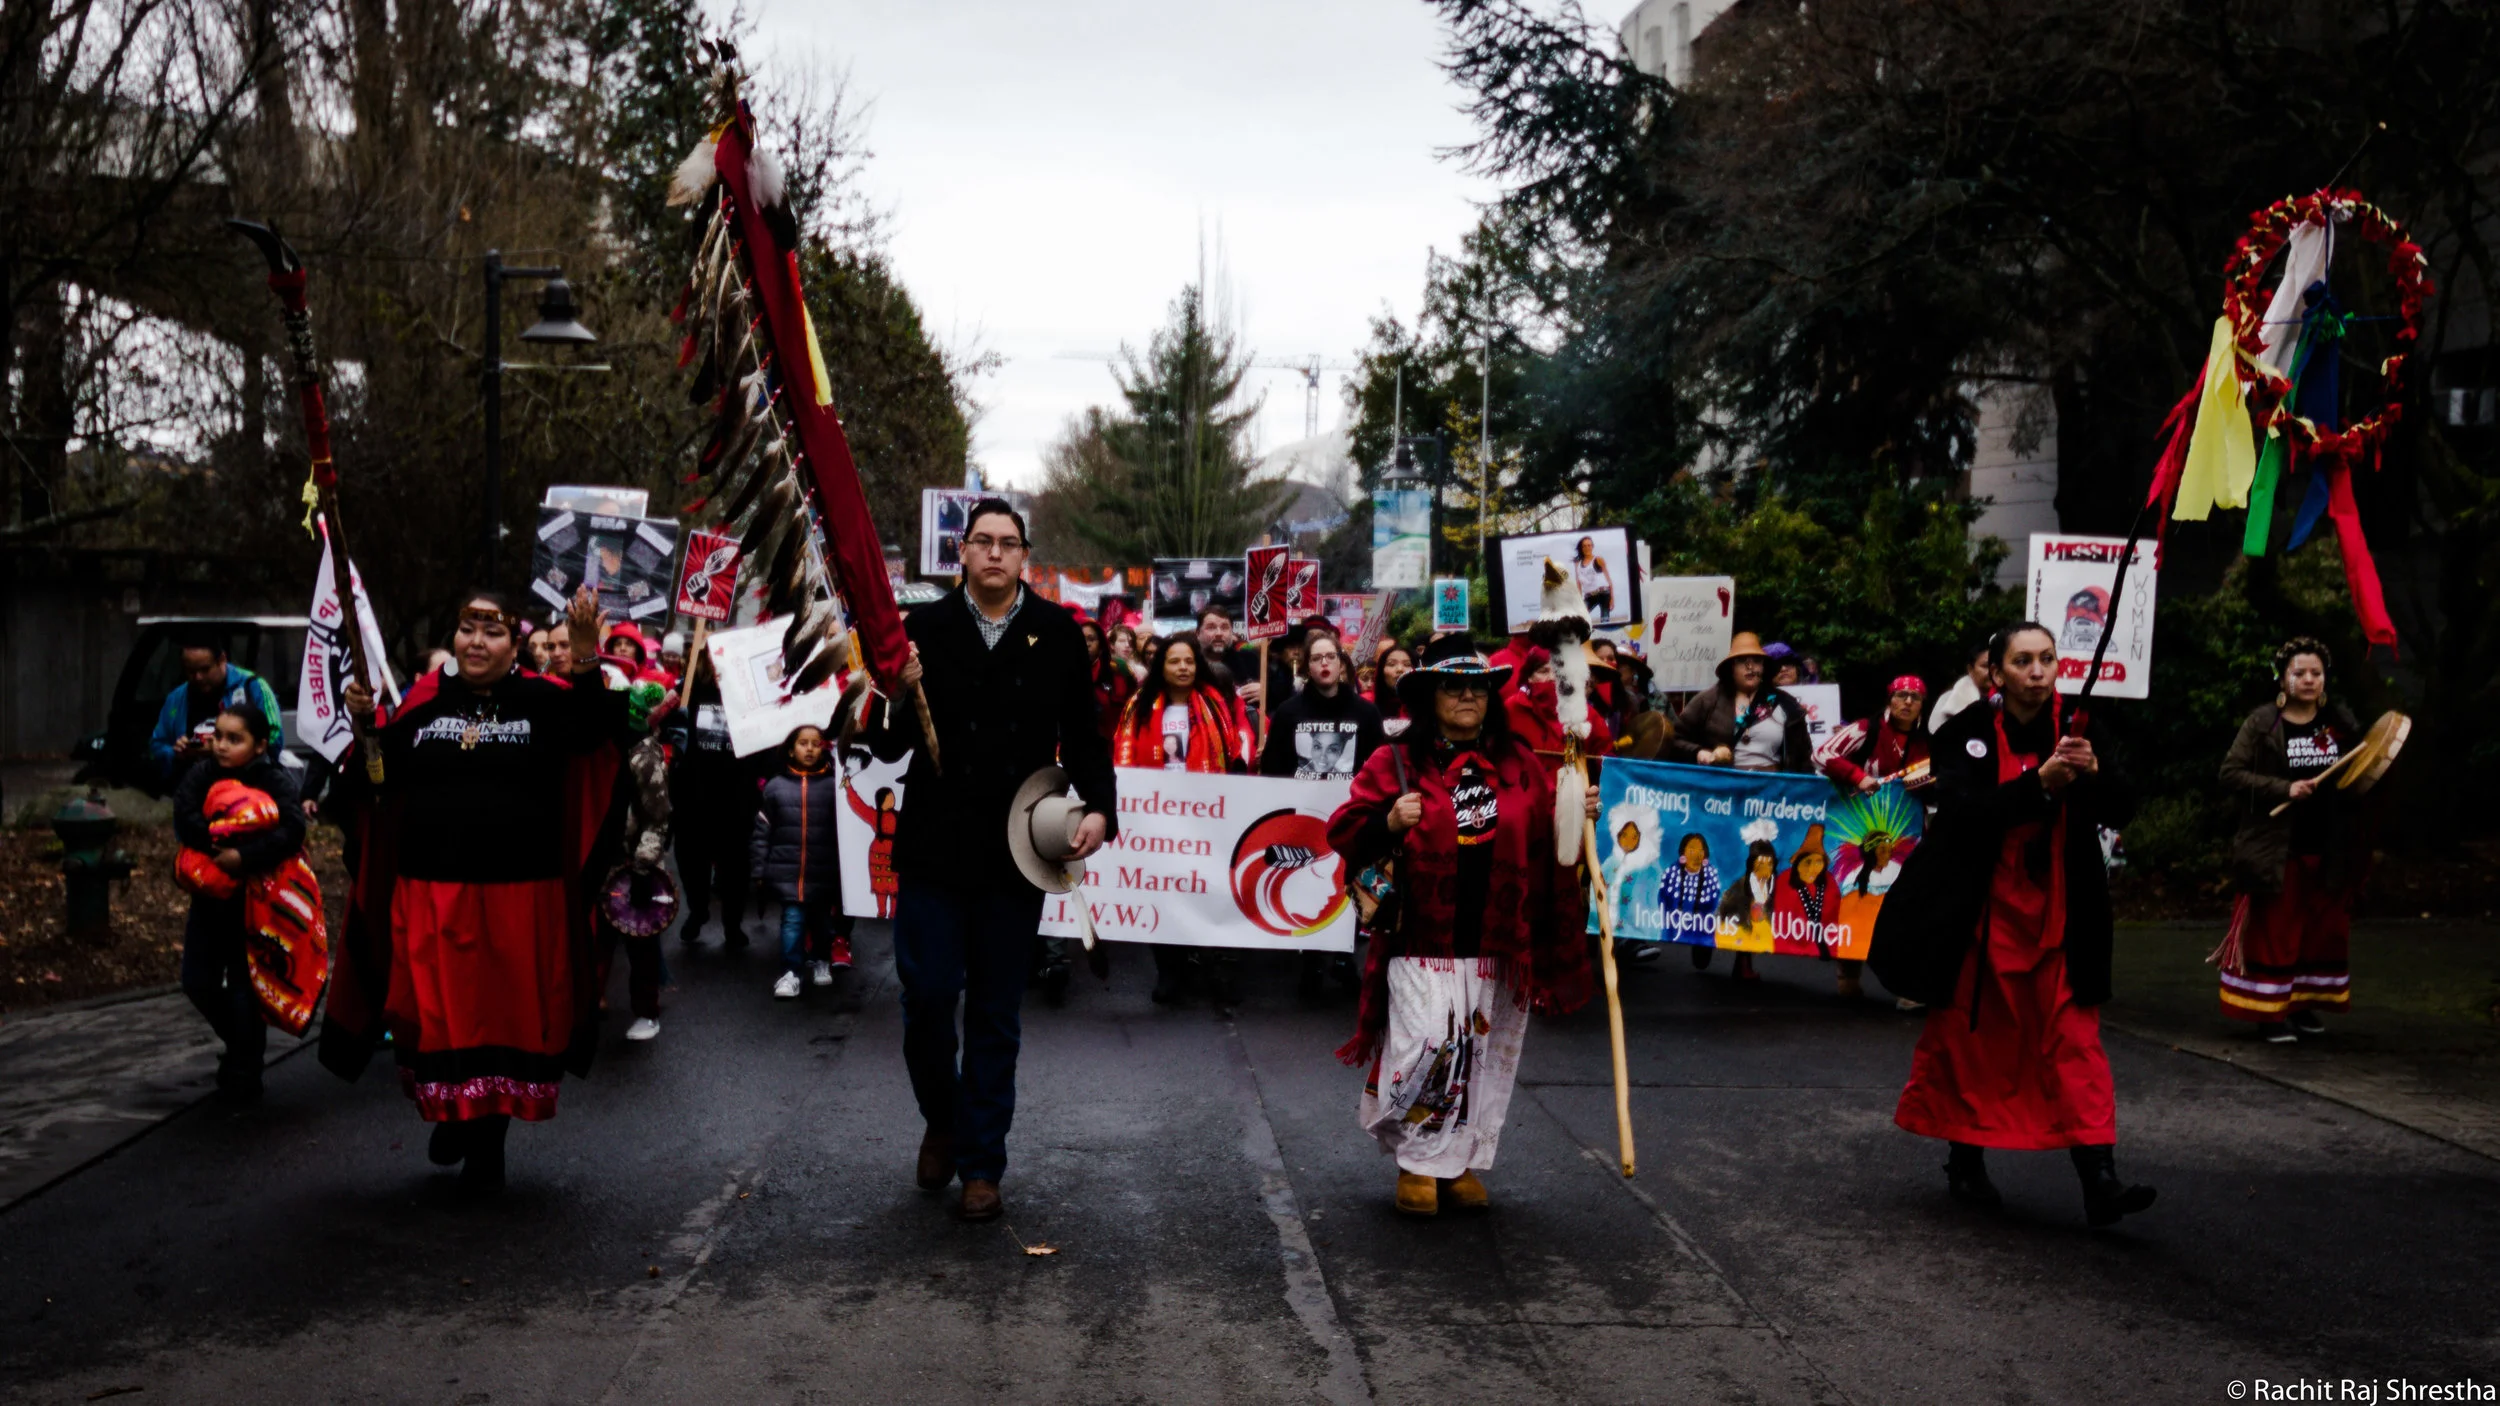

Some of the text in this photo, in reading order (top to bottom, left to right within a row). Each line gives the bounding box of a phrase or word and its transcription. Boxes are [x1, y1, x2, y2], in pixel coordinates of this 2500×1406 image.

[2131, 573, 2149, 661] WOMEN
[1295, 722, 1358, 733] JUSTICE FOR
[1115, 791, 1227, 819] urdered
[1626, 785, 1827, 825] missing and murdered
[1117, 866, 1208, 894] March
[1635, 902, 1740, 941] Indigenous
[1771, 911, 1852, 947] Women
